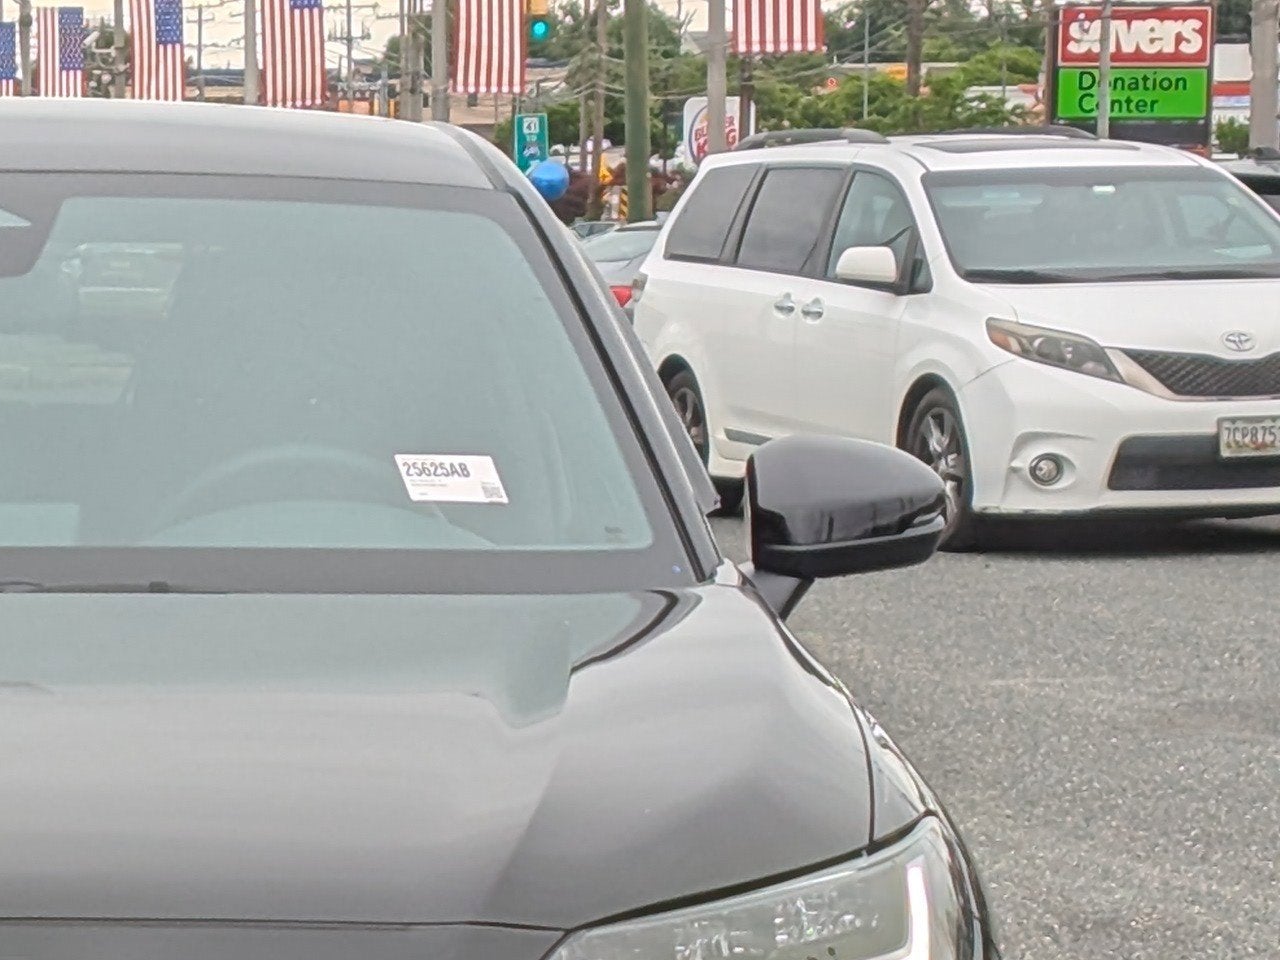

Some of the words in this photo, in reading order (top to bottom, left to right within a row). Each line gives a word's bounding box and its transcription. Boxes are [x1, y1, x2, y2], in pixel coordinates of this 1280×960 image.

[1066, 17, 1204, 54] savers
[1077, 71, 1188, 92] Dnation
[1077, 93, 1160, 114] Cnter
[402, 461, 471, 478] 25625AB
